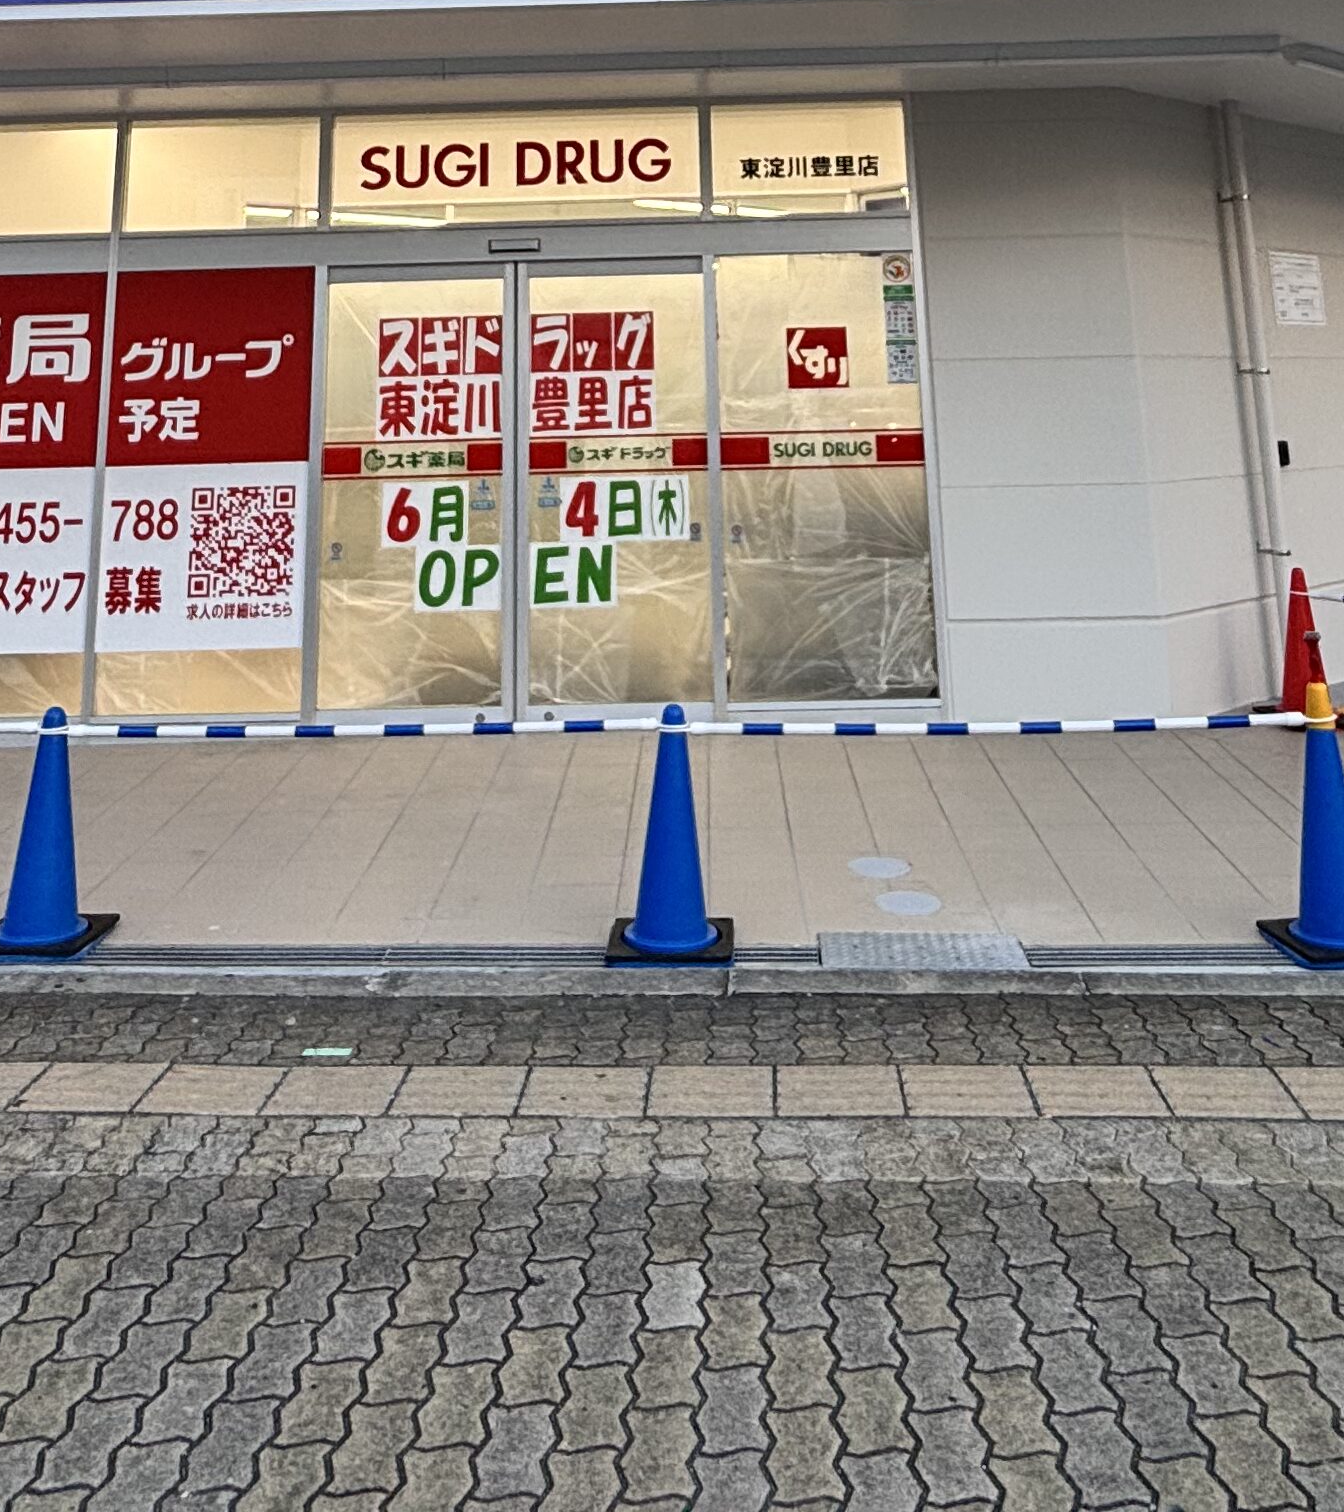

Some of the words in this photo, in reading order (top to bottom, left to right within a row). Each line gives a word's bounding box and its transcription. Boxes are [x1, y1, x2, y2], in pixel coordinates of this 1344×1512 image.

[360, 143, 489, 190] SUGI
[517, 139, 671, 186] DRUG
[740, 155, 879, 179] 東淀川豊里店
[120, 334, 294, 381] グループ
[788, 329, 848, 385] くすり
[119, 398, 200, 442] 予定
[379, 376, 653, 436] 東淀川豊里店
[386, 450, 466, 468] スギ薬局
[773, 441, 816, 458] SUGI
[821, 439, 872, 457] DRUG
[387, 485, 464, 543] 6月
[419, 544, 612, 608] OPEN
[186, 602, 293, 620] 求人の詳細はこちら
